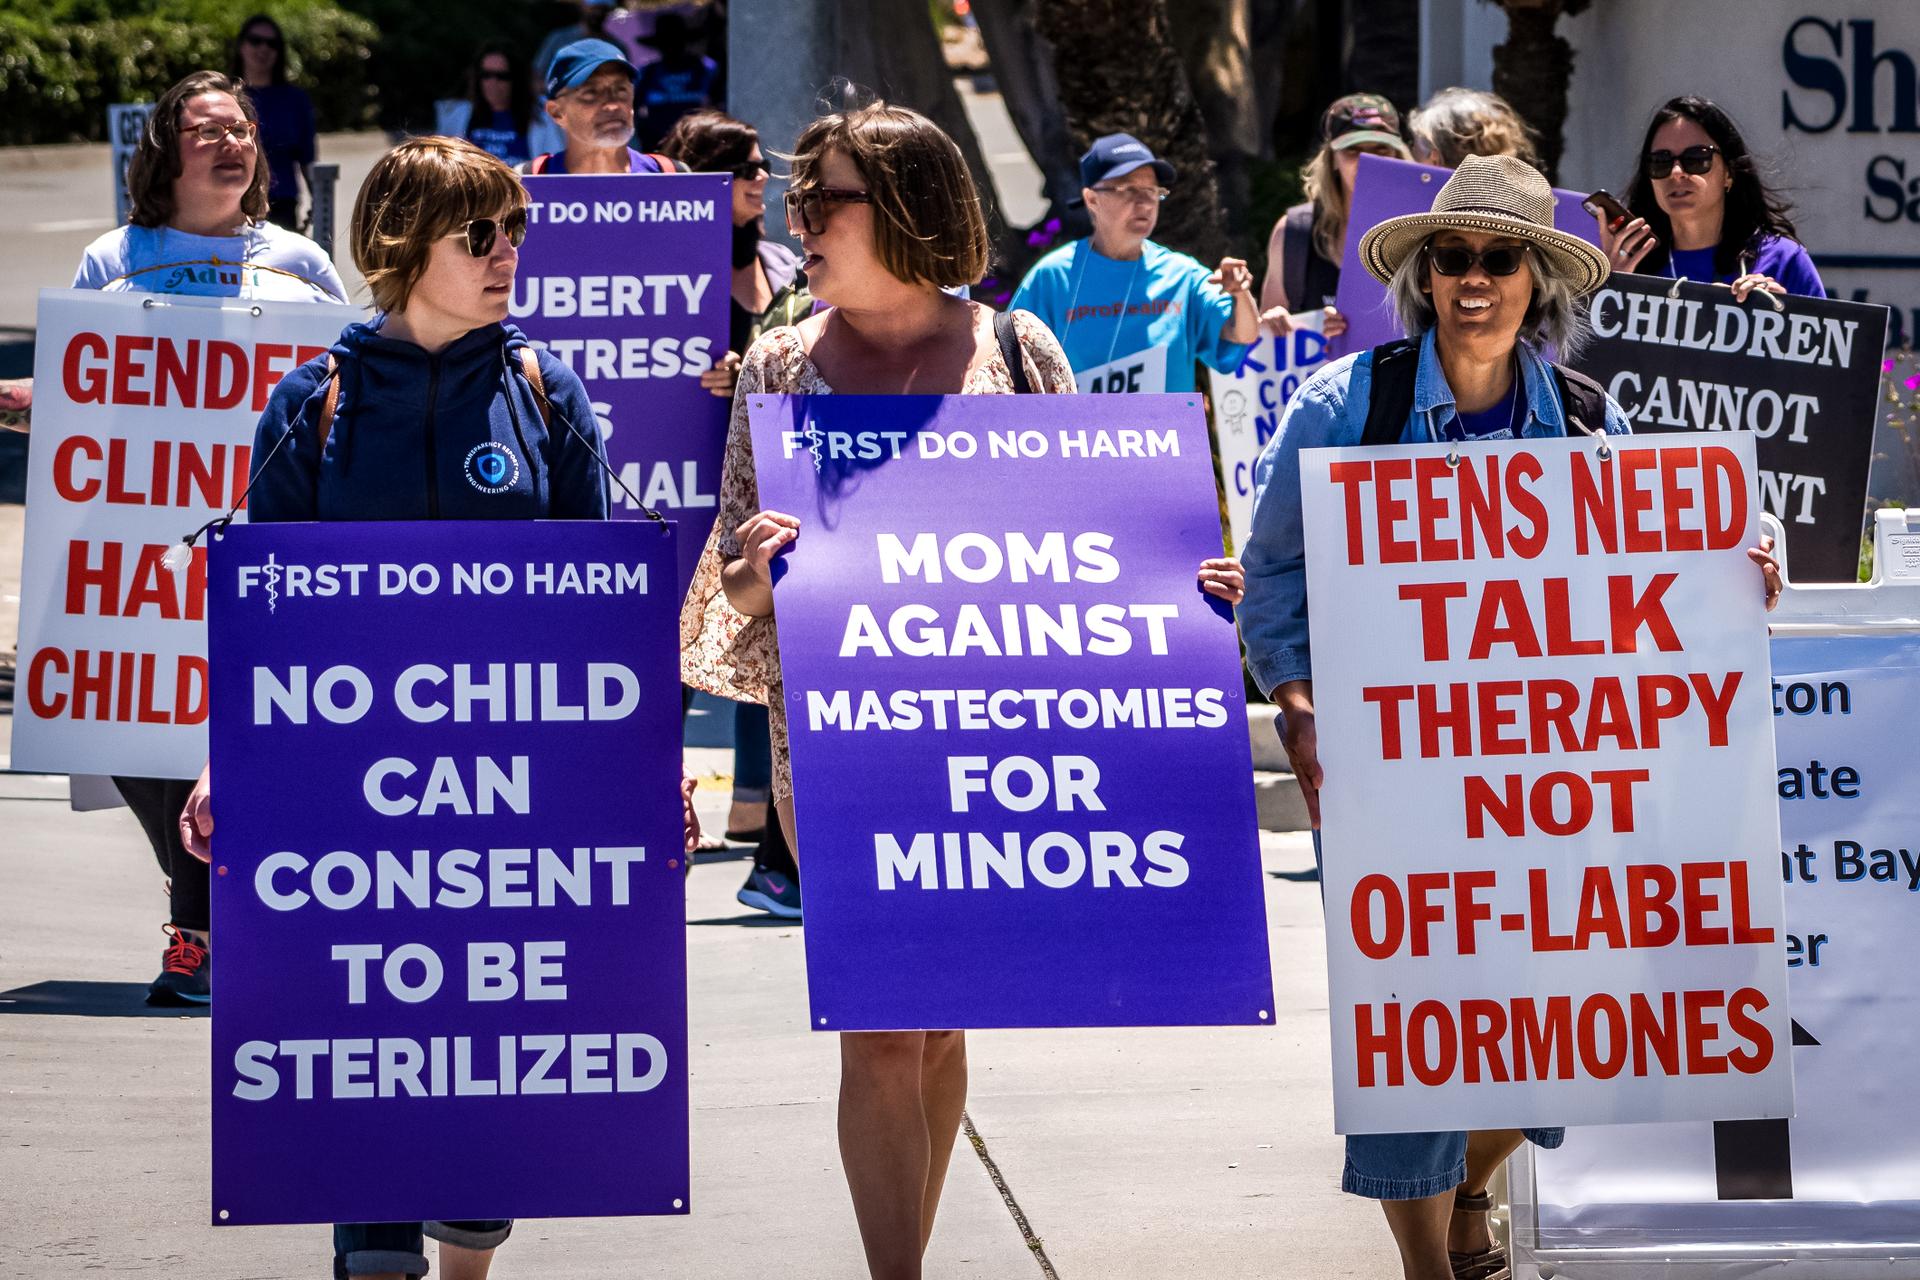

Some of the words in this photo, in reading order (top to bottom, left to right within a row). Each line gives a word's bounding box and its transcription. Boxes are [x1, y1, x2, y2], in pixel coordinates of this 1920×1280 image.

[550, 202, 588, 223] DO
[594, 202, 633, 223] NO
[639, 200, 714, 222] HARM
[1590, 289, 1859, 369] CHILDREN
[1609, 371, 1820, 443] CANNOT
[782, 425, 907, 468] FIRST
[917, 430, 978, 460] DO
[988, 429, 1050, 460] NO
[1060, 429, 1181, 459] HARM
[1330, 452, 1550, 566] TEENS
[1570, 446, 1748, 556] NEED
[238, 556, 367, 609] FIRST
[380, 563, 440, 595] DO
[452, 562, 514, 595] NO
[526, 563, 648, 595] HARM
[876, 532, 1121, 584] MOMS
[838, 604, 1179, 658] AGAINST
[1398, 573, 1683, 662] TALK
[253, 665, 374, 725] NO
[394, 663, 641, 722] CHILD
[806, 688, 1228, 731] MASTECTOMIES
[1363, 672, 1743, 761] THERAPY
[363, 756, 530, 816] CAN
[947, 755, 1107, 813] FOR
[1464, 769, 1650, 839] NOT
[254, 846, 646, 911] CONSENT
[874, 830, 1190, 891] MINORS
[1834, 840, 1920, 891] Bay
[1350, 860, 1775, 960] OFF-LABEL
[331, 943, 444, 1004] TO
[467, 941, 568, 1002] BE
[232, 1033, 669, 1101] STERILIZED
[1354, 987, 1774, 1088] HORMONES
